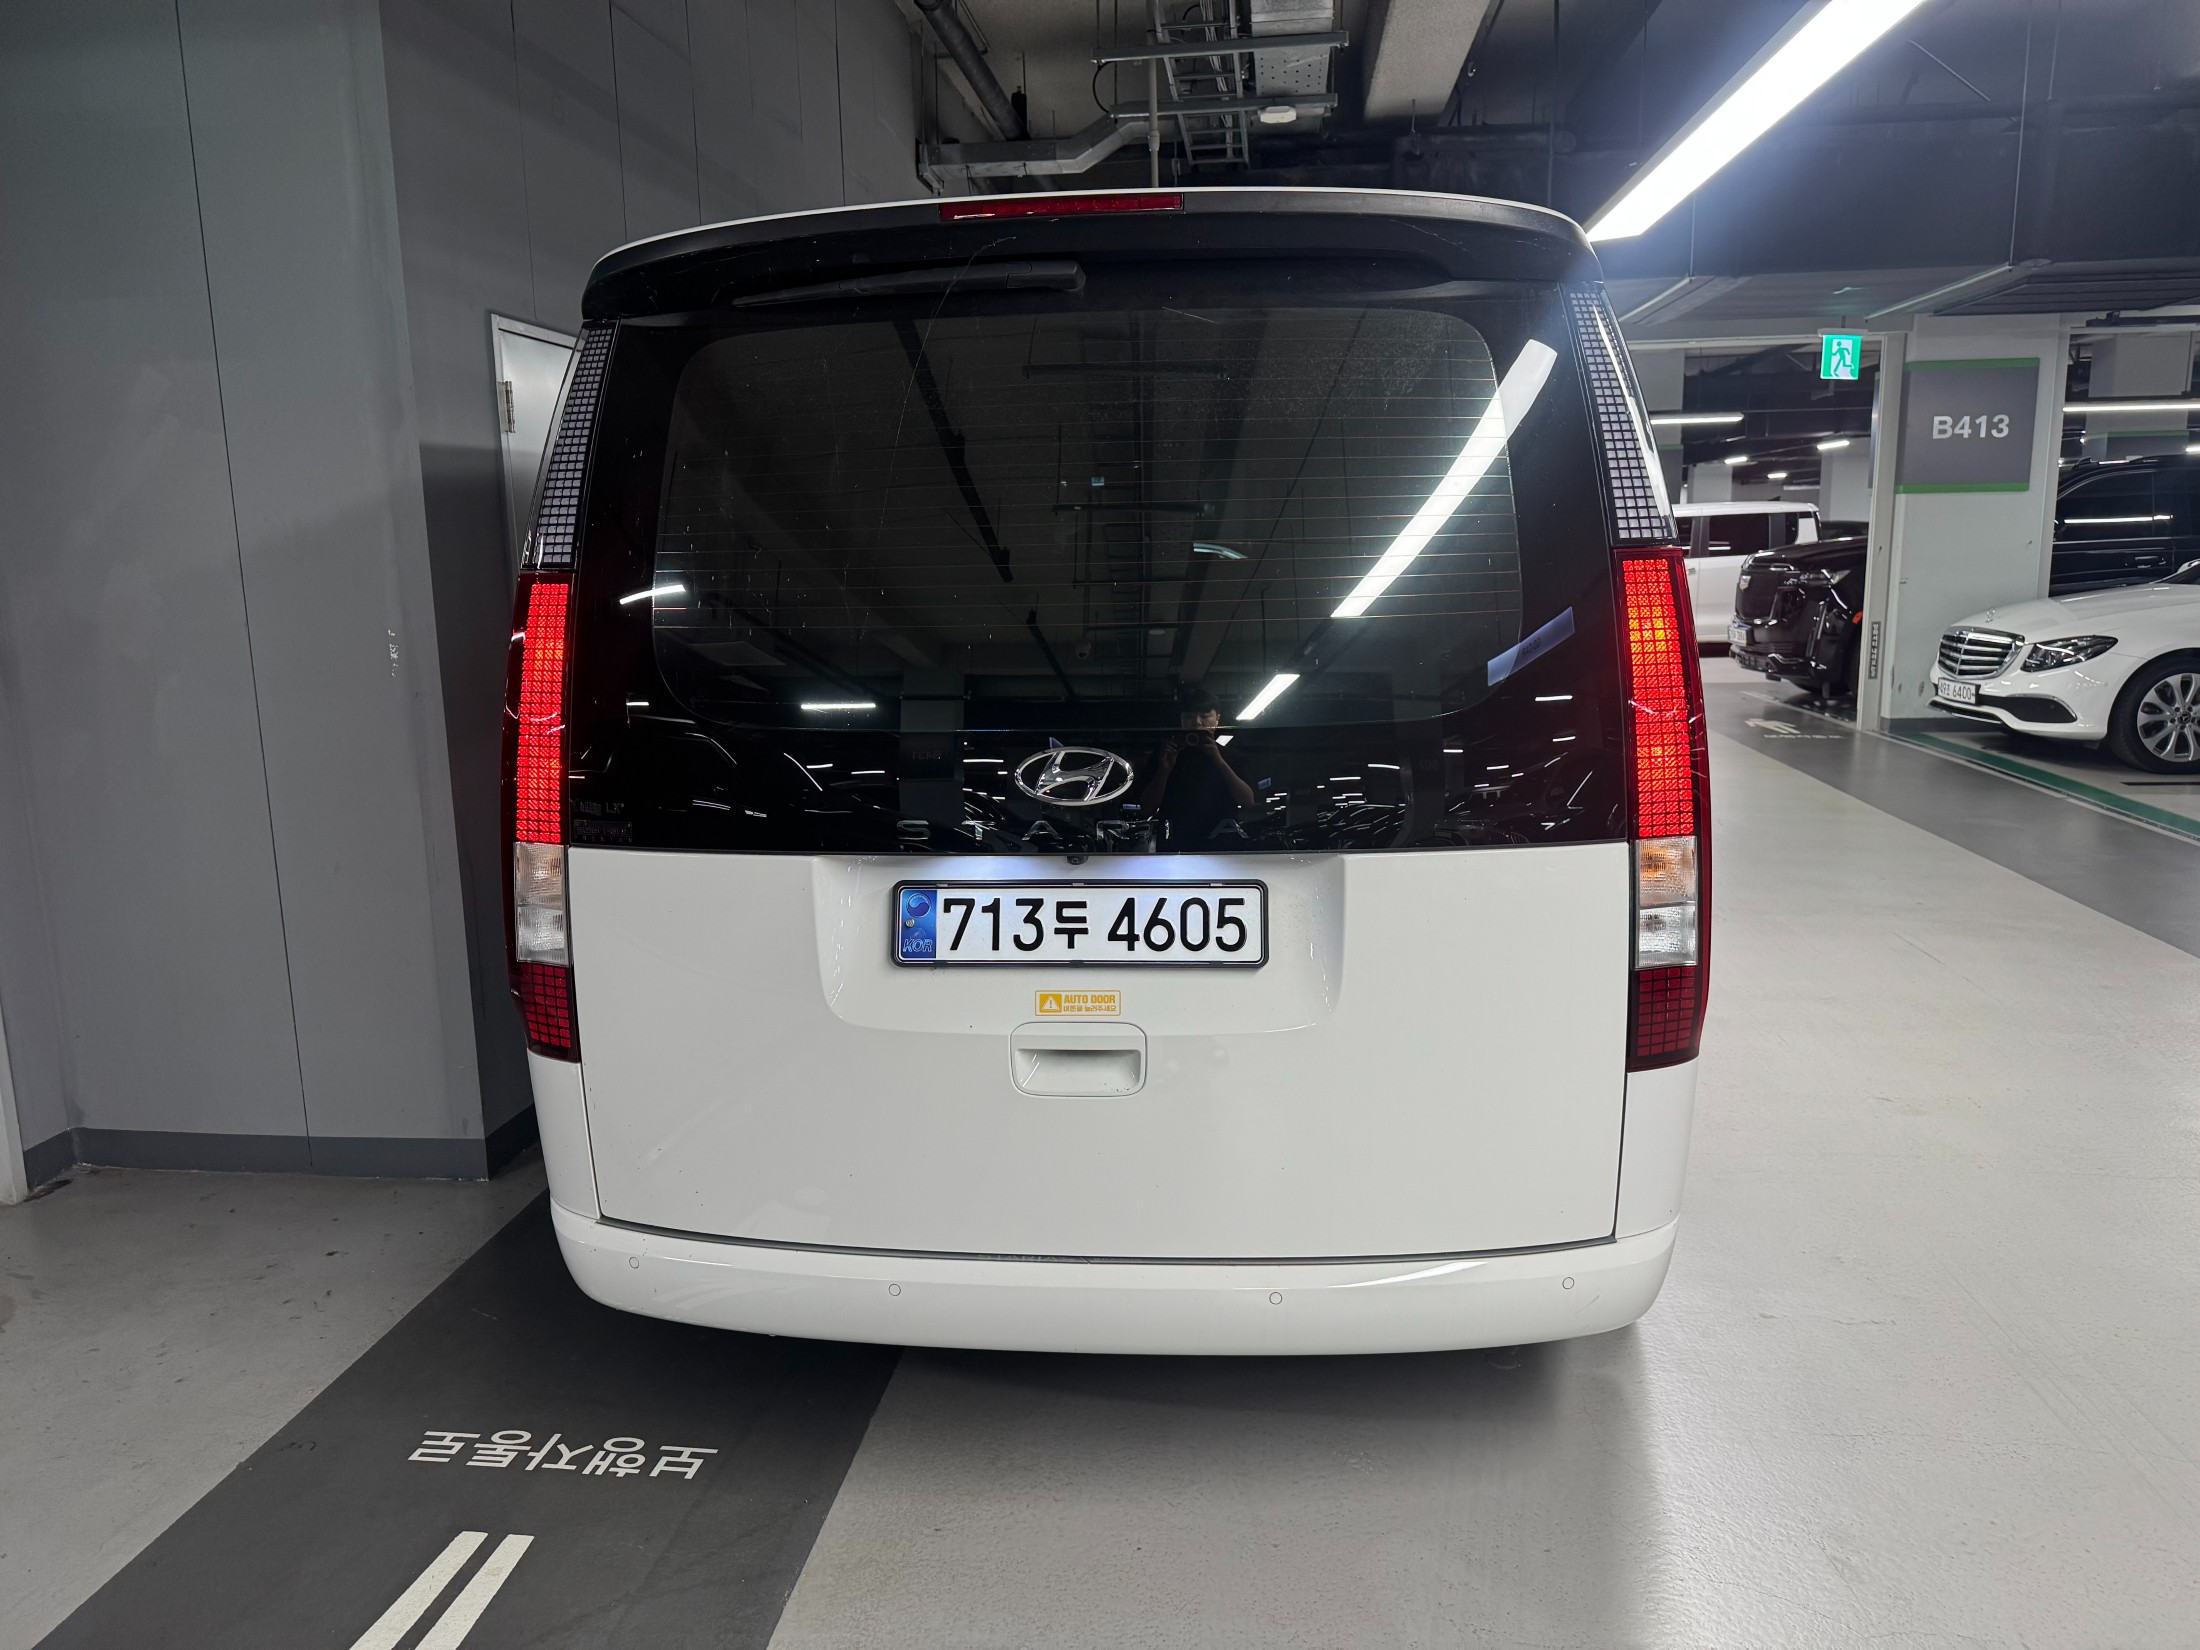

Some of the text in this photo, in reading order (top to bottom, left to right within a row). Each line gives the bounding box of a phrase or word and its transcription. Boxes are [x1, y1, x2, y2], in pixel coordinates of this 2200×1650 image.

[1932, 414, 2010, 440] B413
[1952, 685, 1971, 700] 6400
[896, 819, 1250, 841] STARIA
[943, 897, 1247, 952] 713두 4605
[902, 938, 933, 953] KOR
[1064, 994, 1116, 1004] AUTO DOOR
[408, 1429, 719, 1480] 보행자통로
